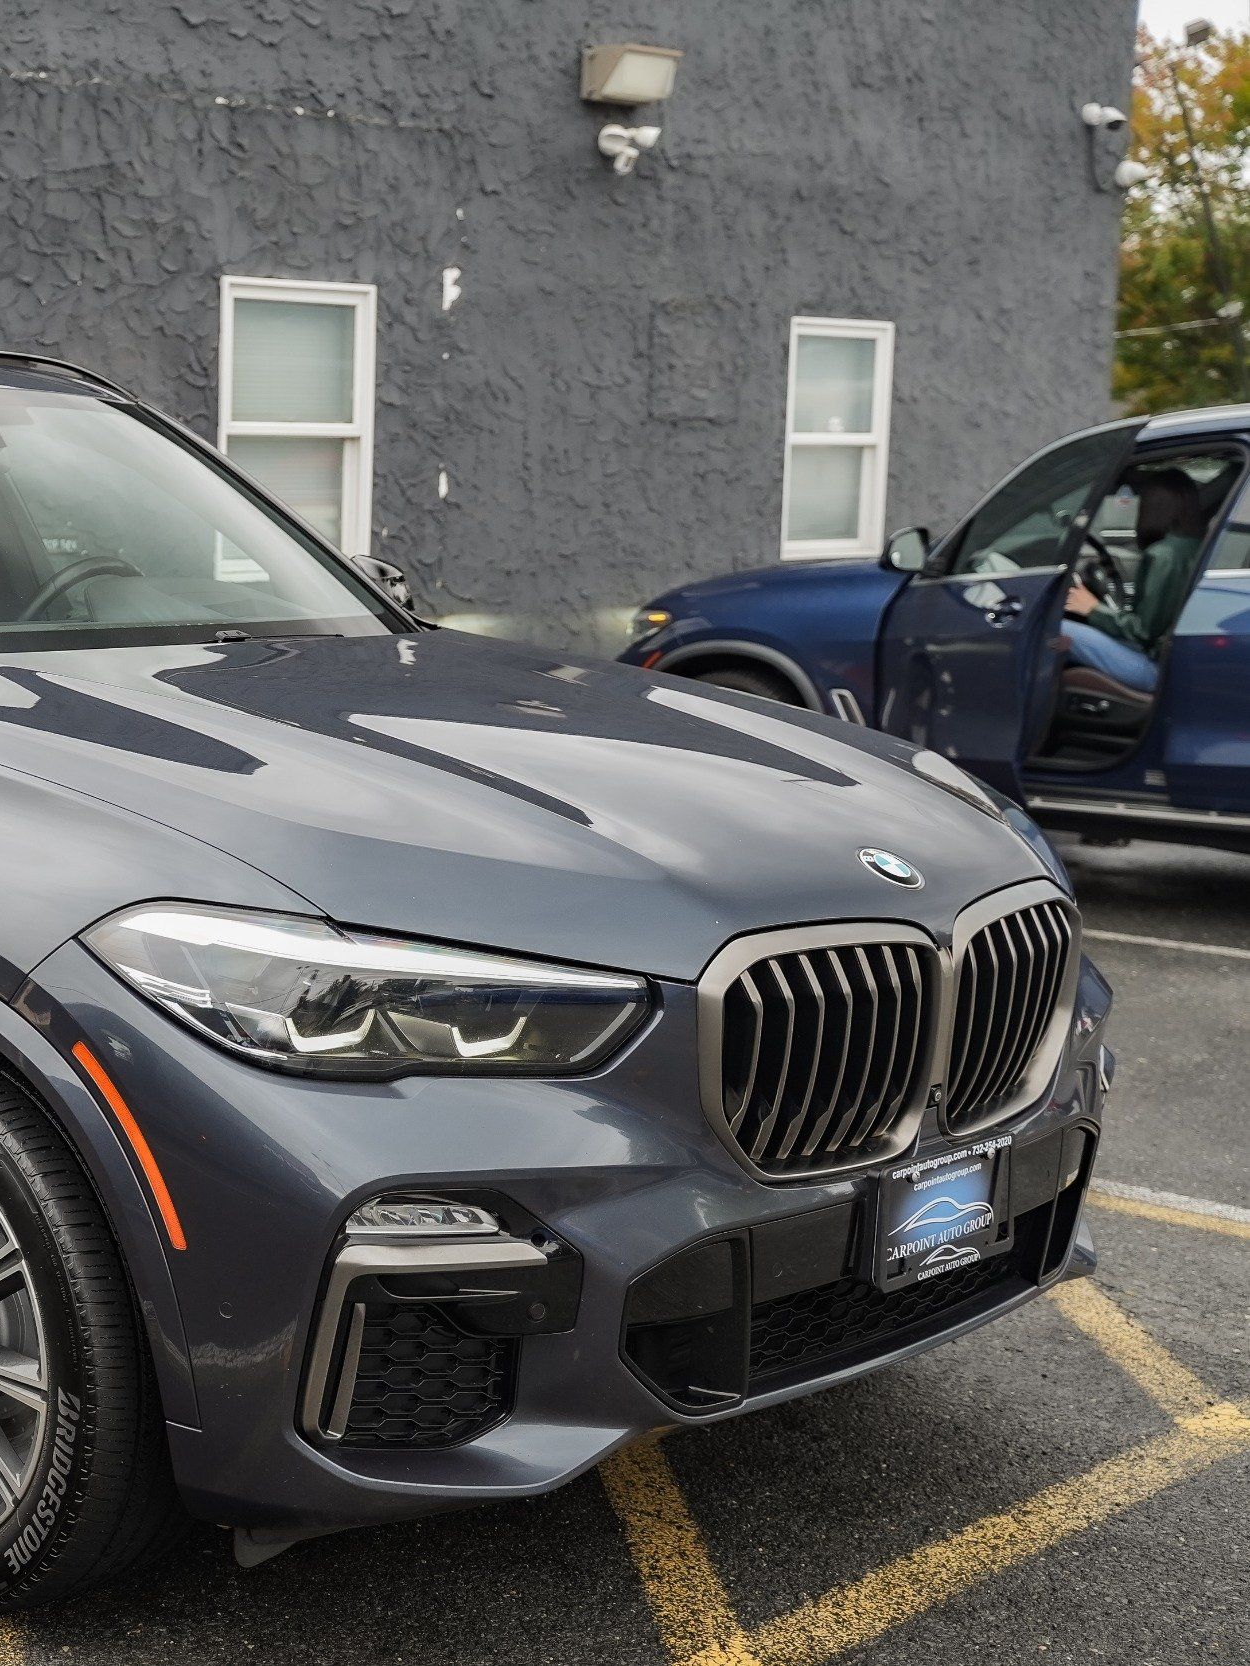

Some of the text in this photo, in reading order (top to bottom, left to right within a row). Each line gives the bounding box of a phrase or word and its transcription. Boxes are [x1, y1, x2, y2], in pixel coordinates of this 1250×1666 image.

[892, 1149, 967, 1179] carpointautogroup.com
[914, 1162, 981, 1191] carpointautogroup.com
[937, 1225, 962, 1244] AUTO
[963, 1212, 992, 1234] GROUP
[917, 1253, 979, 1281] CARPOINT AUTO GROUP
[3, 1386, 81, 1575] BRIDGESTONE
